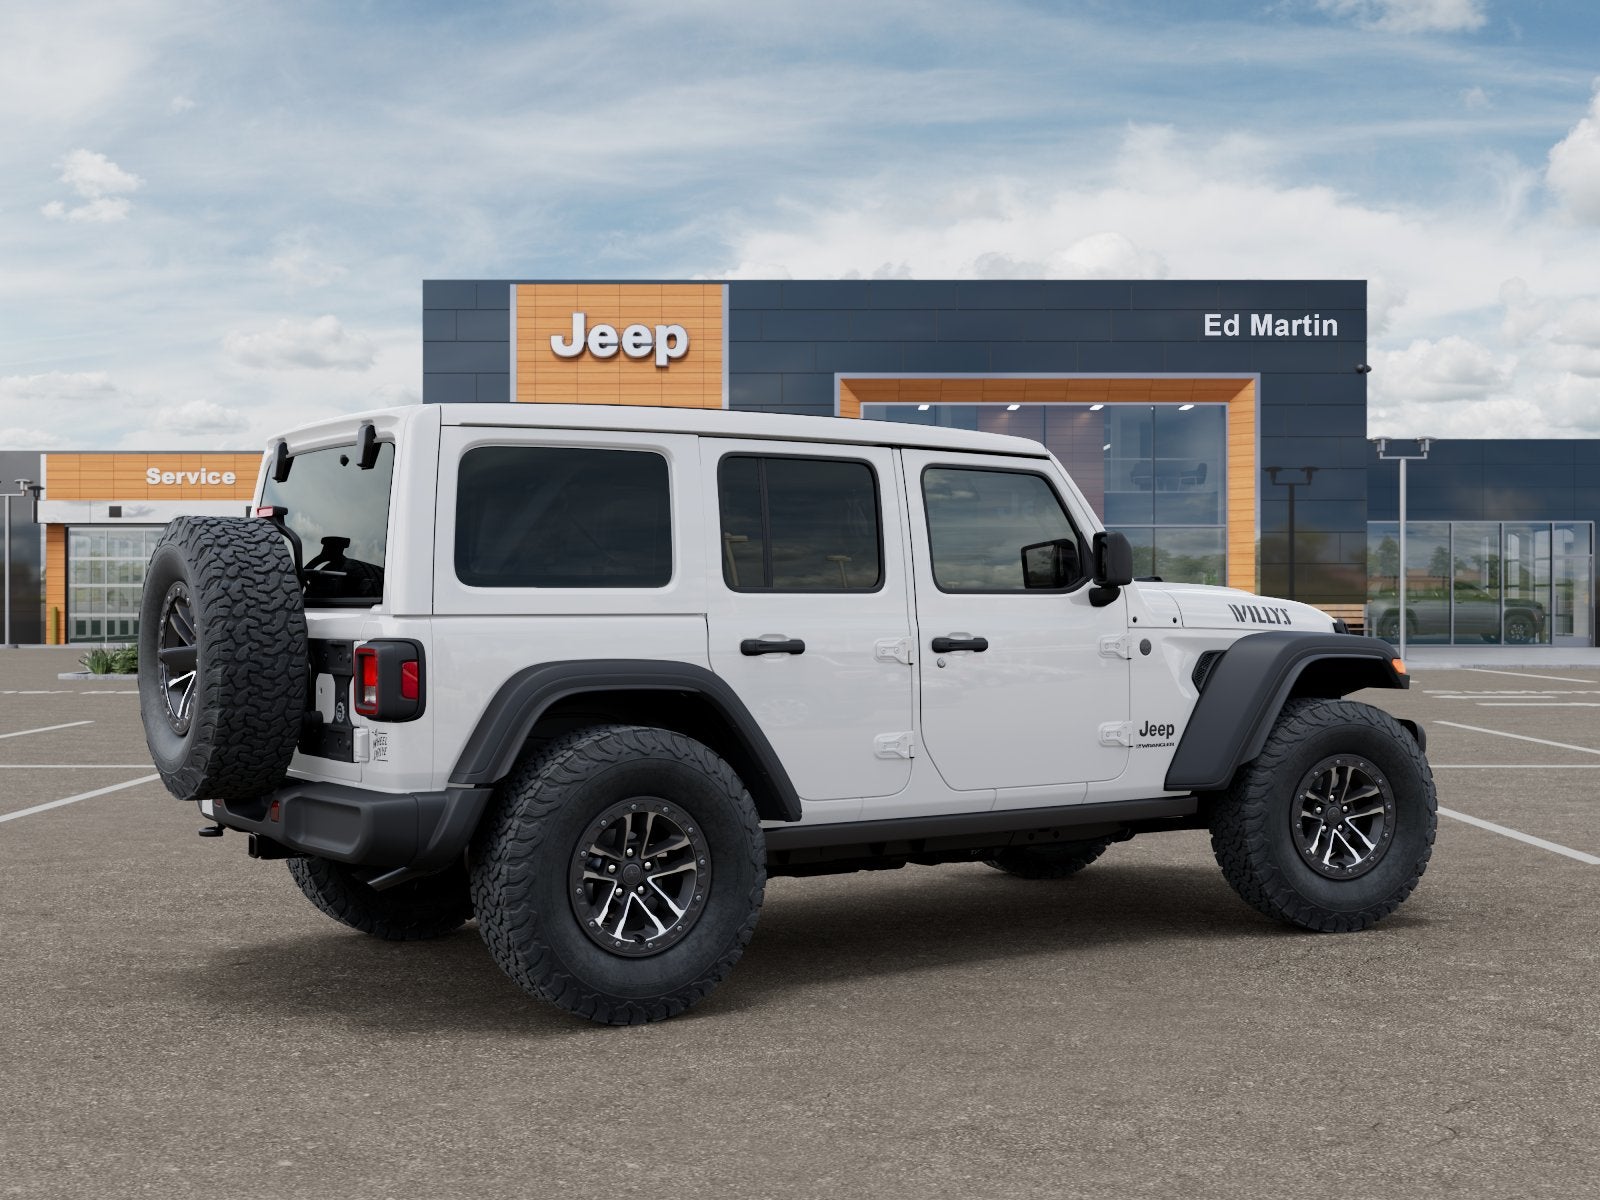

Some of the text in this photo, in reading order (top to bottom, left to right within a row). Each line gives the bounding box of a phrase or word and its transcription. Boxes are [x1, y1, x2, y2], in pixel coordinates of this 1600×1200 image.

[1204, 313, 1338, 337] Ed Martin
[550, 312, 688, 367] Jeep
[146, 467, 236, 485] Service
[1227, 603, 1292, 625] WILLYS
[1139, 720, 1175, 739] Jeep
